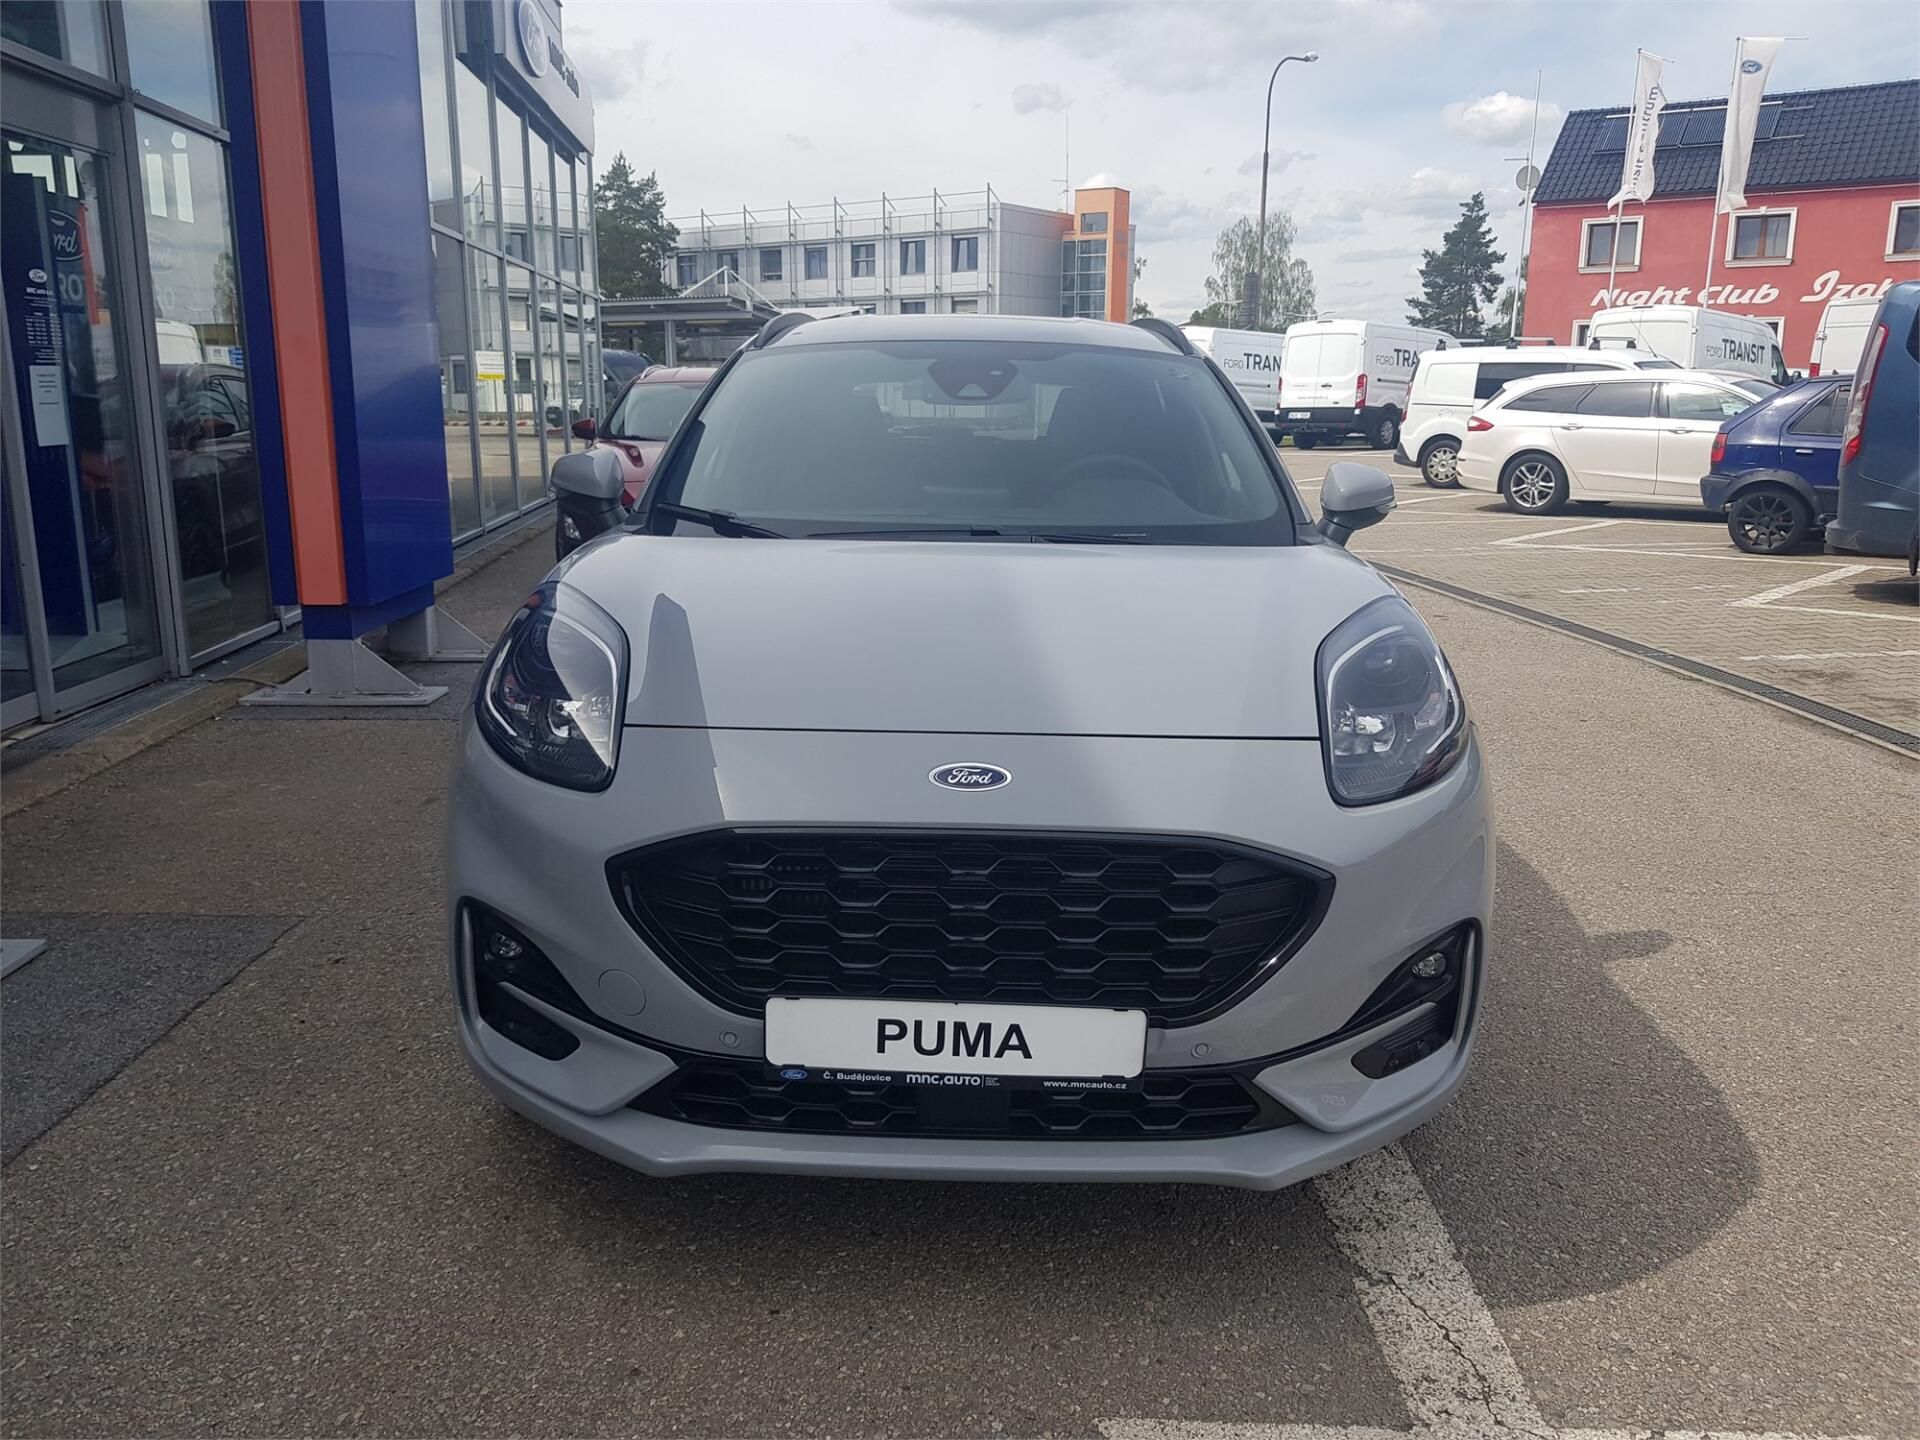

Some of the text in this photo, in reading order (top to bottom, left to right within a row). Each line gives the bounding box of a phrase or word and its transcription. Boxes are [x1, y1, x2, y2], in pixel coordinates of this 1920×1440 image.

[1590, 286, 1691, 306] Night
[1697, 284, 1780, 304] Club
[1706, 338, 1765, 365] FORD TRANSIT
[1223, 358, 1243, 370] FORD
[1376, 354, 1394, 366] FORD
[947, 767, 993, 784] Ford
[876, 1018, 1033, 1060] PUMA
[837, 1072, 892, 1082] Budějovice
[1043, 1080, 1127, 1090] www.mncauto.cz
